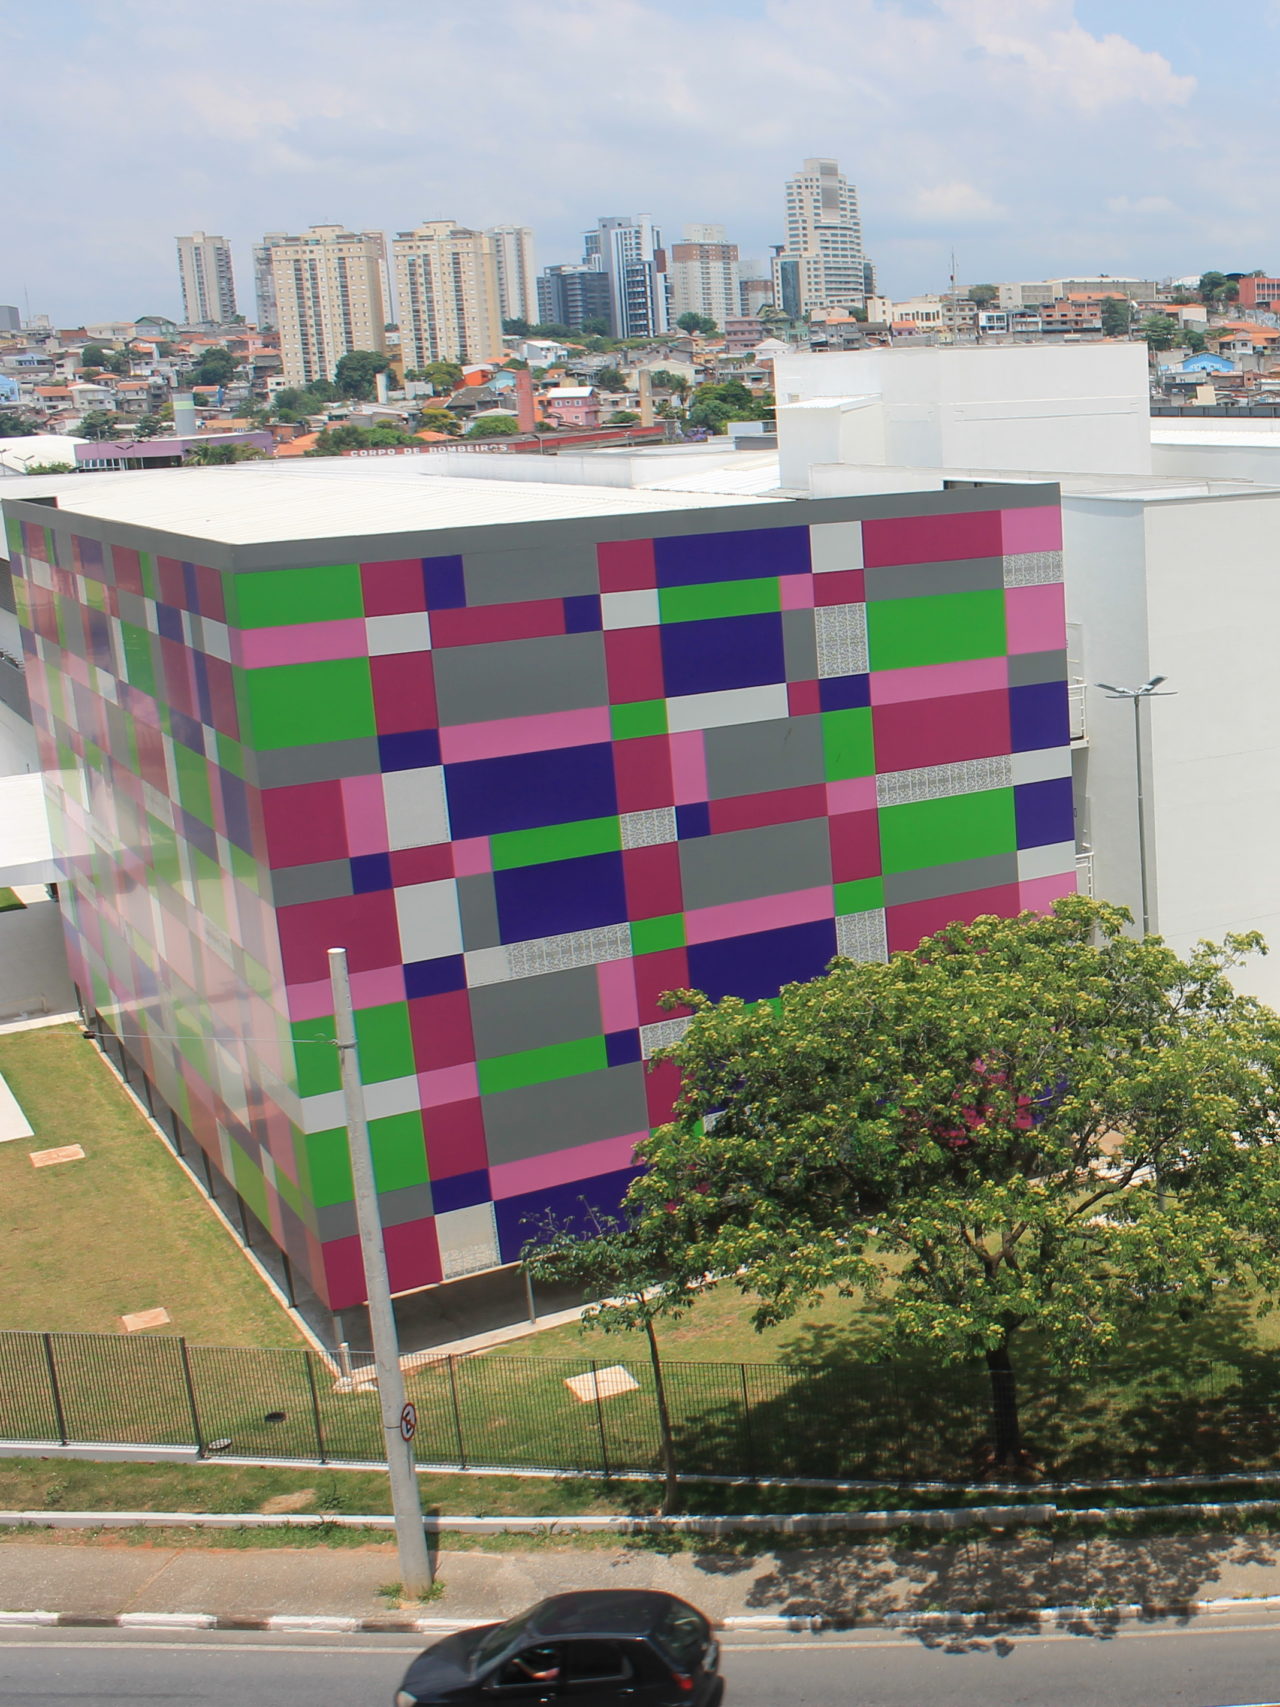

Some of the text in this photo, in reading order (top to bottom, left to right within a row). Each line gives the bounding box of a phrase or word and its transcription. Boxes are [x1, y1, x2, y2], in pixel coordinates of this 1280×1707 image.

[350, 444, 508, 457] CORPO DE BOMBEIROS
